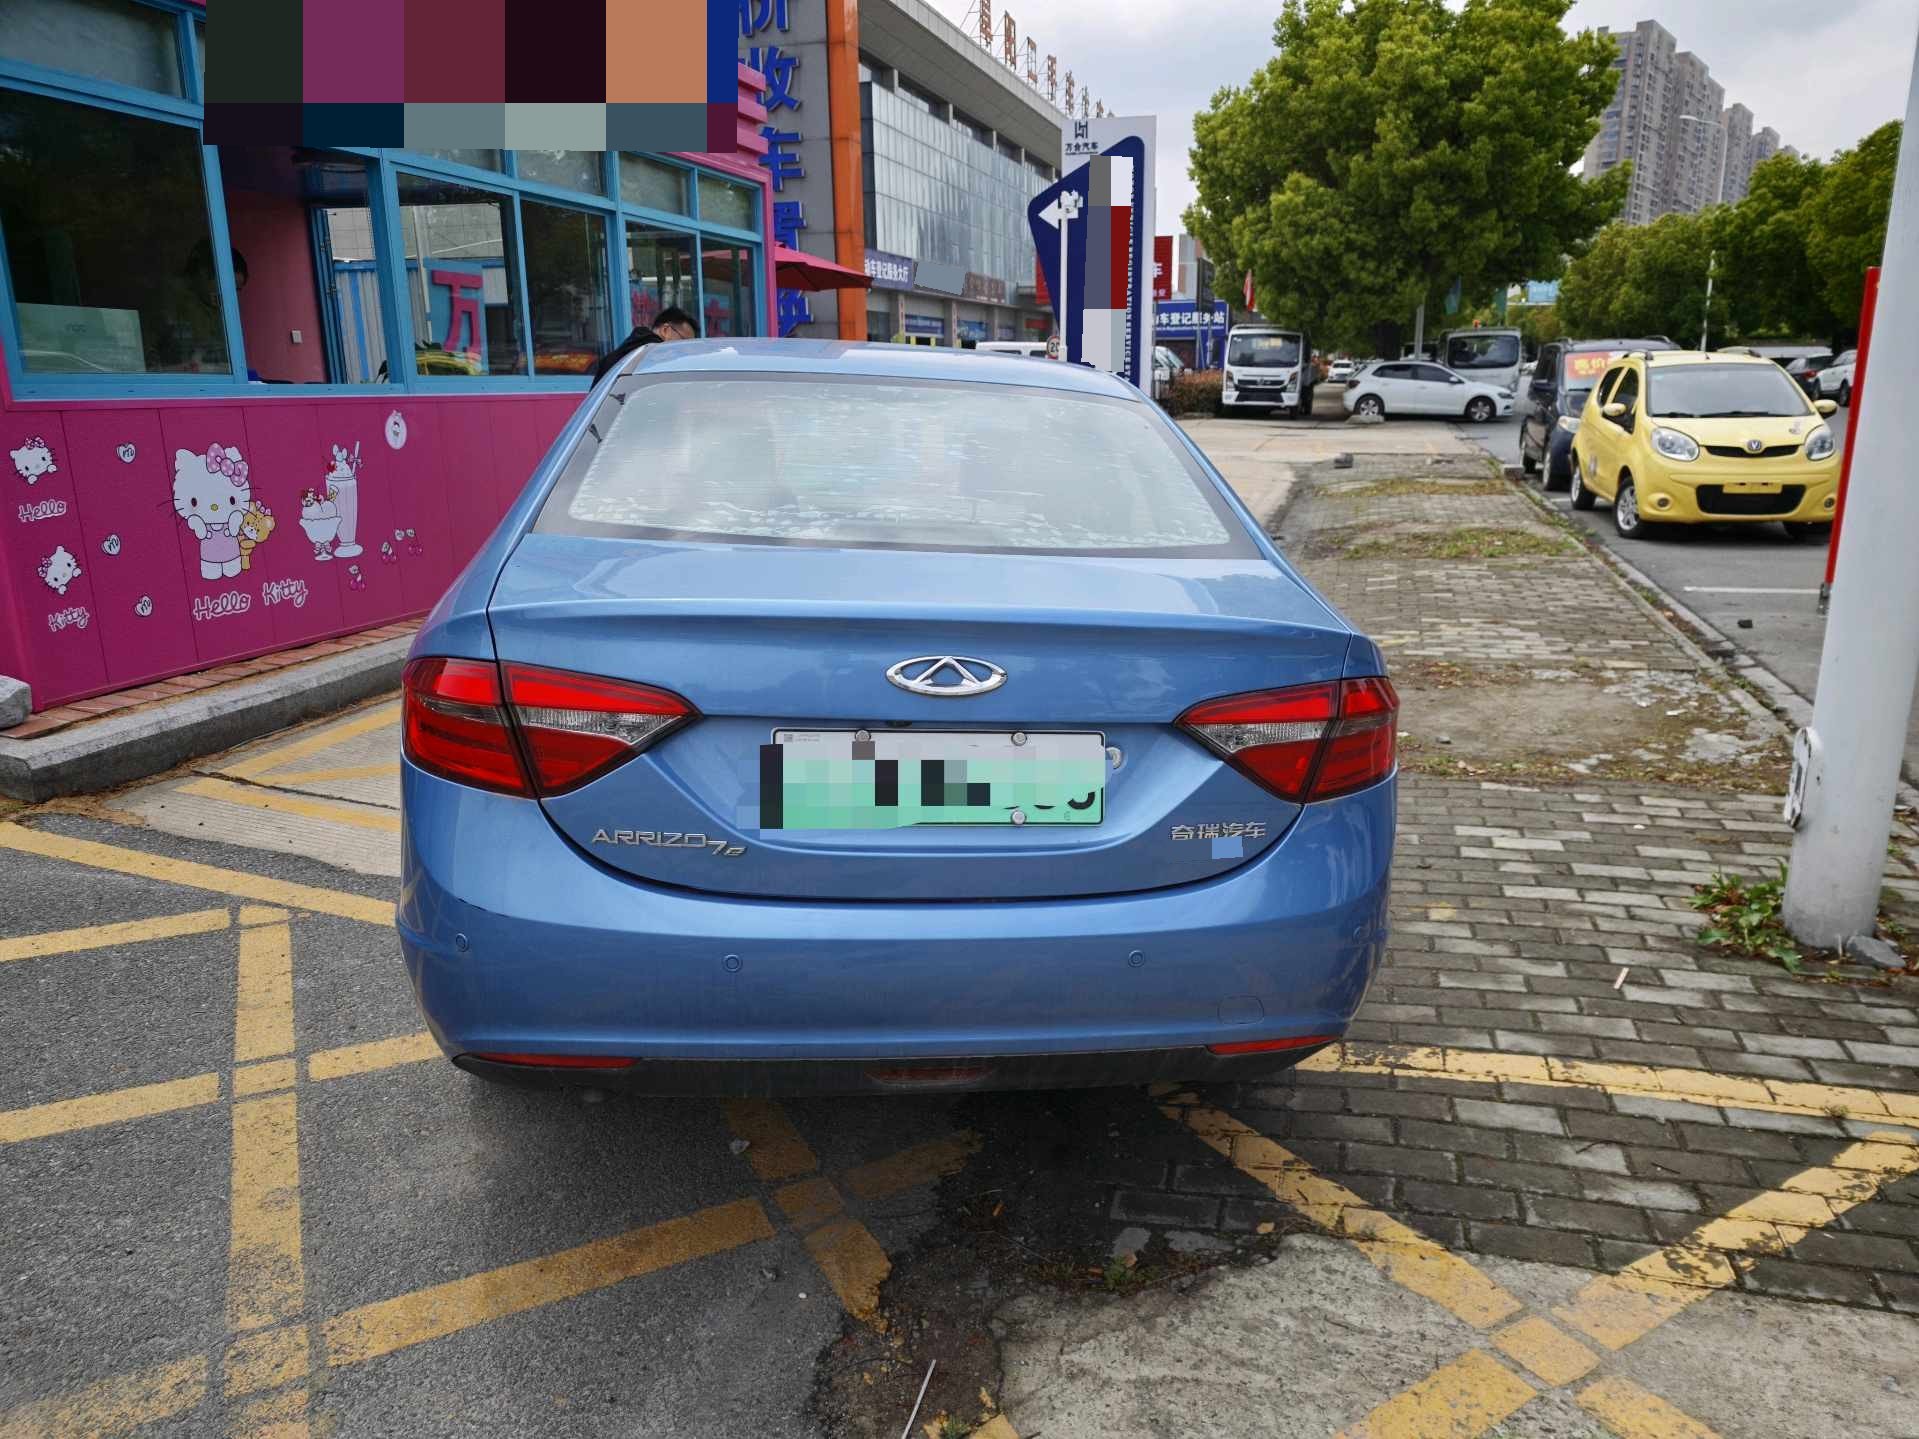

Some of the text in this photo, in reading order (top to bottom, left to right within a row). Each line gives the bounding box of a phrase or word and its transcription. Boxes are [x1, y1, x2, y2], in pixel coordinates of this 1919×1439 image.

[1156, 310, 1225, 326] 车登记服务站
[19, 499, 67, 522] Hello
[193, 579, 308, 620] Hello Kitty
[48, 606, 90, 632] Kitty
[592, 829, 707, 848] ARRIZO
[1170, 822, 1267, 841] 奇瑞汽车
